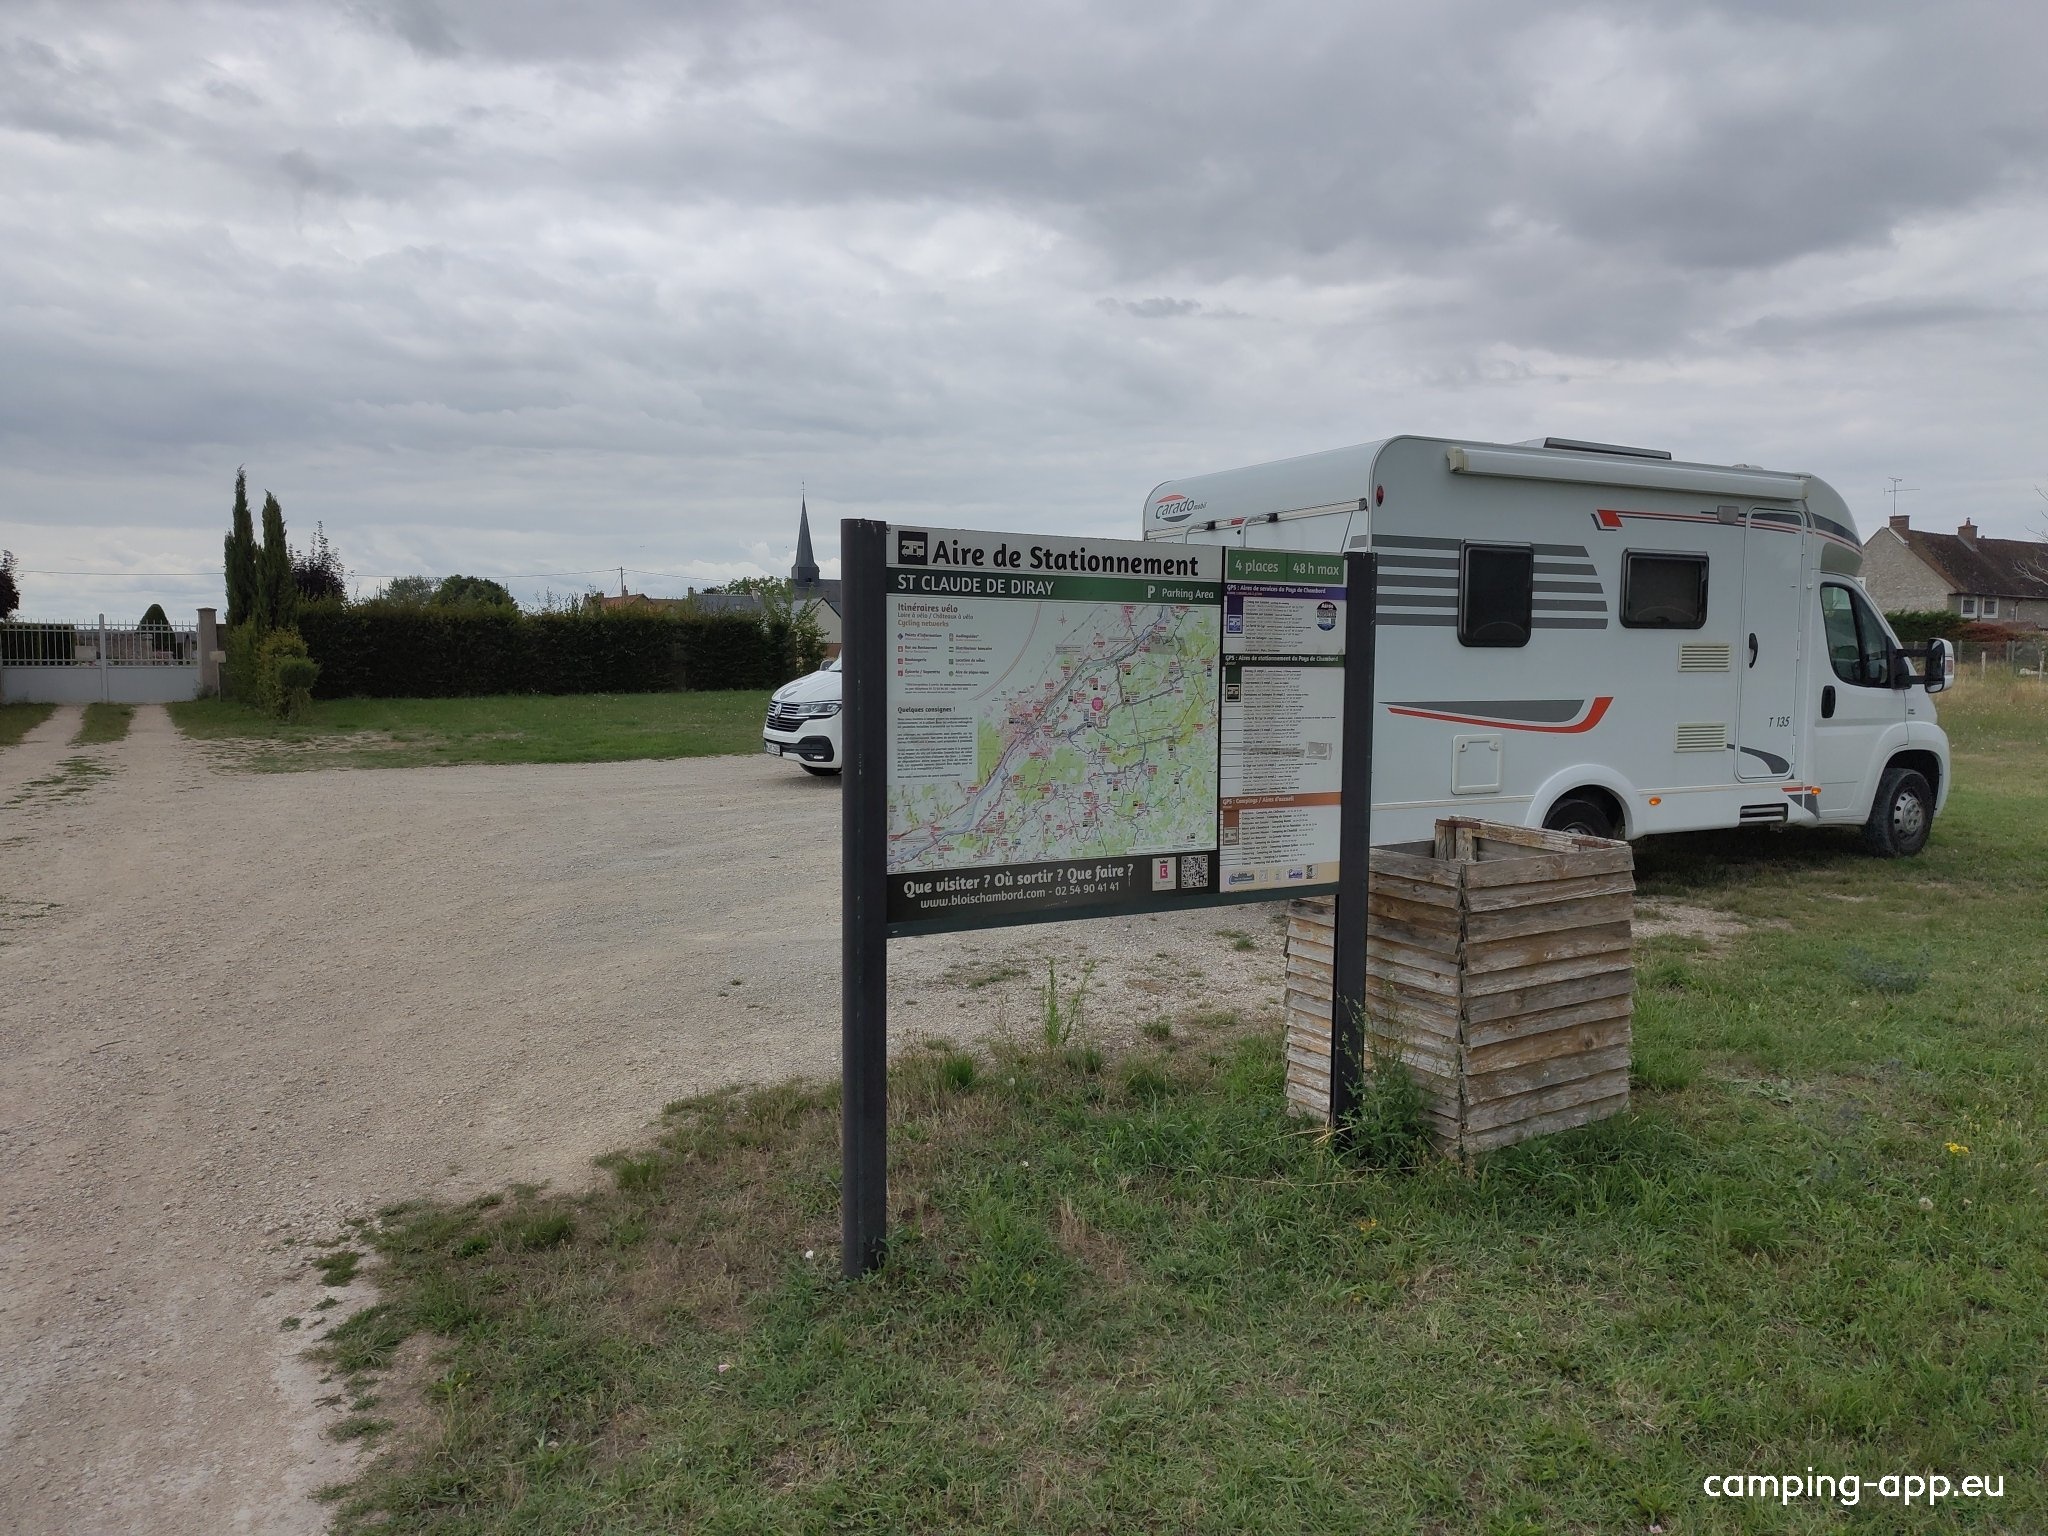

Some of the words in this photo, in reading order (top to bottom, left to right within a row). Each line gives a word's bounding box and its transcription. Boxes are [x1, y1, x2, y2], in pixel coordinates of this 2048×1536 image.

[932, 540, 984, 566] Aire
[993, 543, 1021, 568] de
[1030, 546, 1198, 577] Stationnement
[1235, 560, 1242, 571] 4
[1245, 560, 1279, 574] places
[1293, 562, 1306, 574] 48
[1317, 565, 1339, 576] max
[898, 574, 916, 590] ST
[921, 575, 981, 593] CLAUDE
[986, 578, 1006, 594] DE
[1011, 579, 1054, 595] DIRAY
[1147, 585, 1156, 598] P
[1162, 588, 1194, 600] Parking
[1195, 589, 1214, 599] Area
[897, 603, 939, 613] Itinéraires
[941, 603, 958, 613] vélo
[898, 619, 920, 627] Cycling
[897, 706, 924, 714] Quelques
[1768, 717, 1774, 727] T
[1776, 716, 1790, 728] 135
[903, 881, 932, 898] Que
[936, 876, 980, 892] visiter
[983, 874, 991, 888] ?
[994, 870, 1013, 887] Où
[1017, 868, 1053, 885] sortir
[1056, 868, 1064, 882] ?
[1067, 868, 1092, 884] Que
[1095, 864, 1124, 882] faire
[1127, 863, 1134, 876] ?
[920, 888, 1046, 909] www.bloischambord.com
[1055, 886, 1067, 896] 02
[1069, 885, 1080, 894] 54
[1083, 883, 1095, 893] 90
[1097, 882, 1107, 892] 41
[1109, 881, 1119, 891] 41
